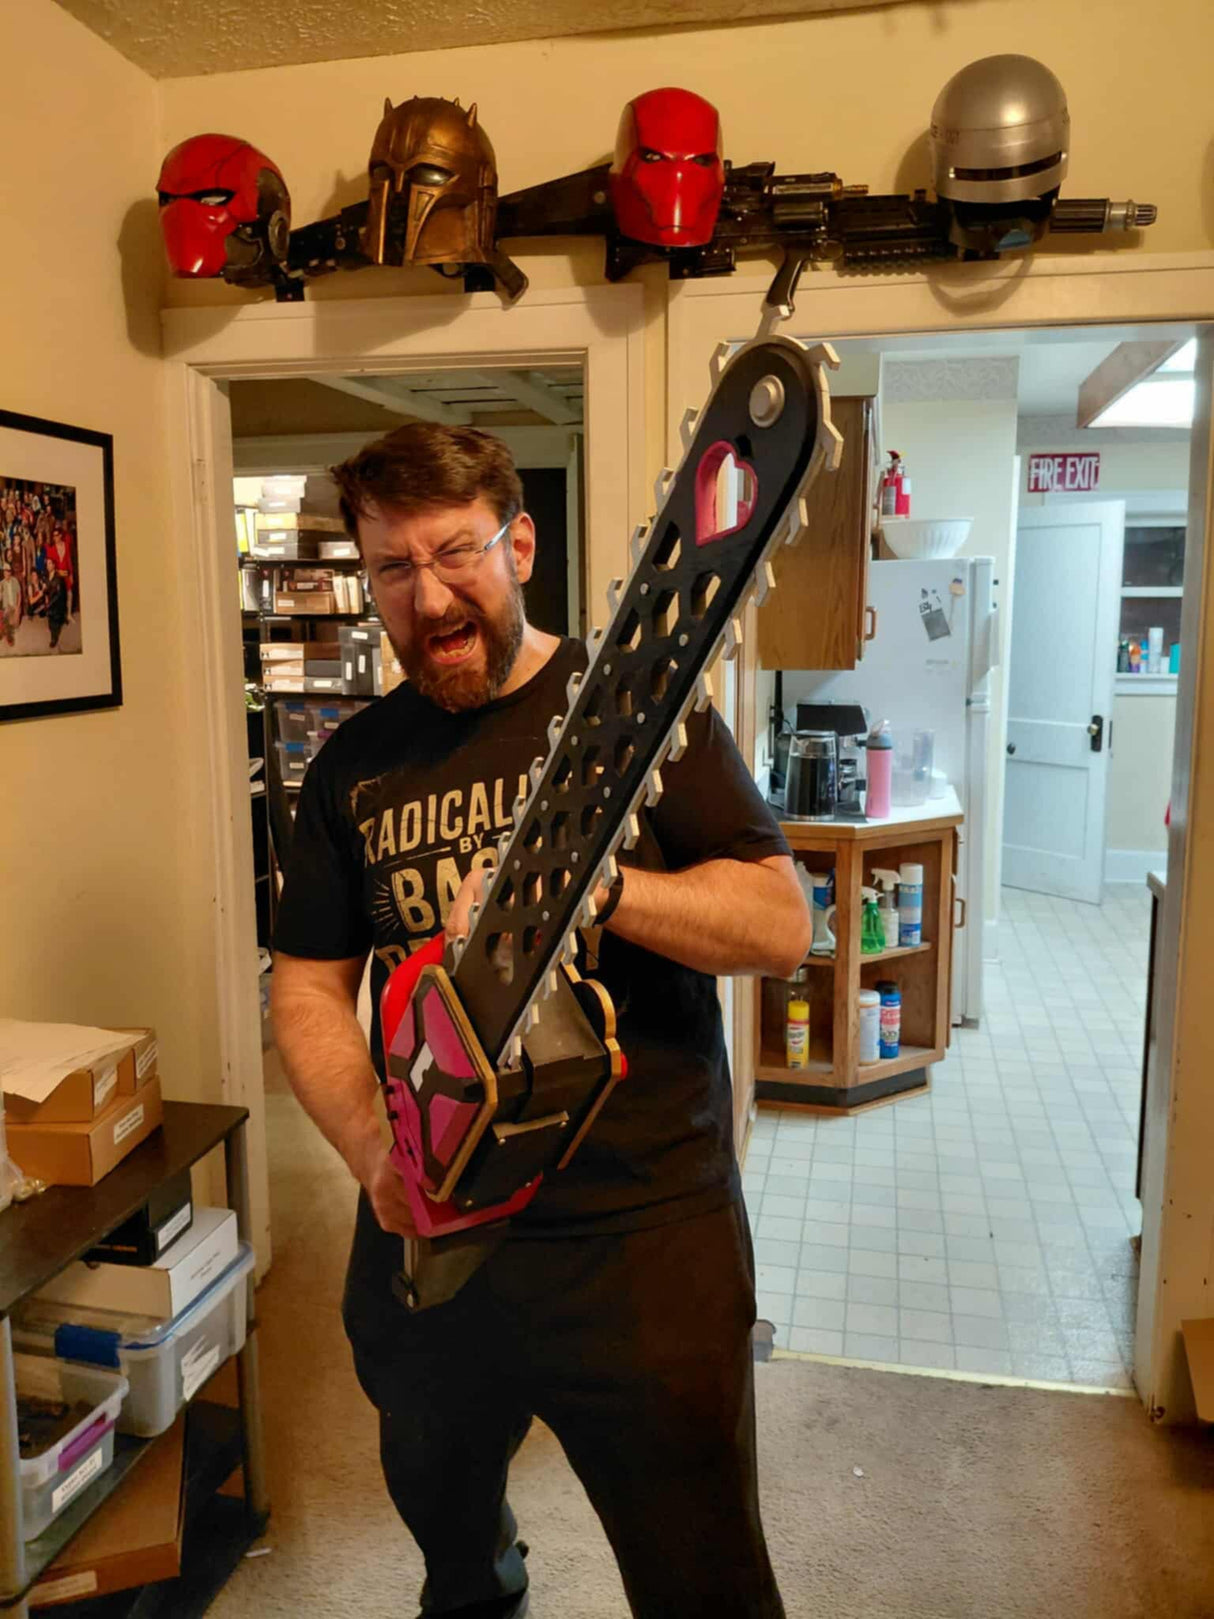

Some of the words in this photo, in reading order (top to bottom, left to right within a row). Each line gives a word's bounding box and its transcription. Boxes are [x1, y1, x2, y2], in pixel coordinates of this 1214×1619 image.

[1029, 458, 1063, 490] FIRE
[1065, 457, 1099, 489] EXIT
[459, 832, 484, 854] BY
